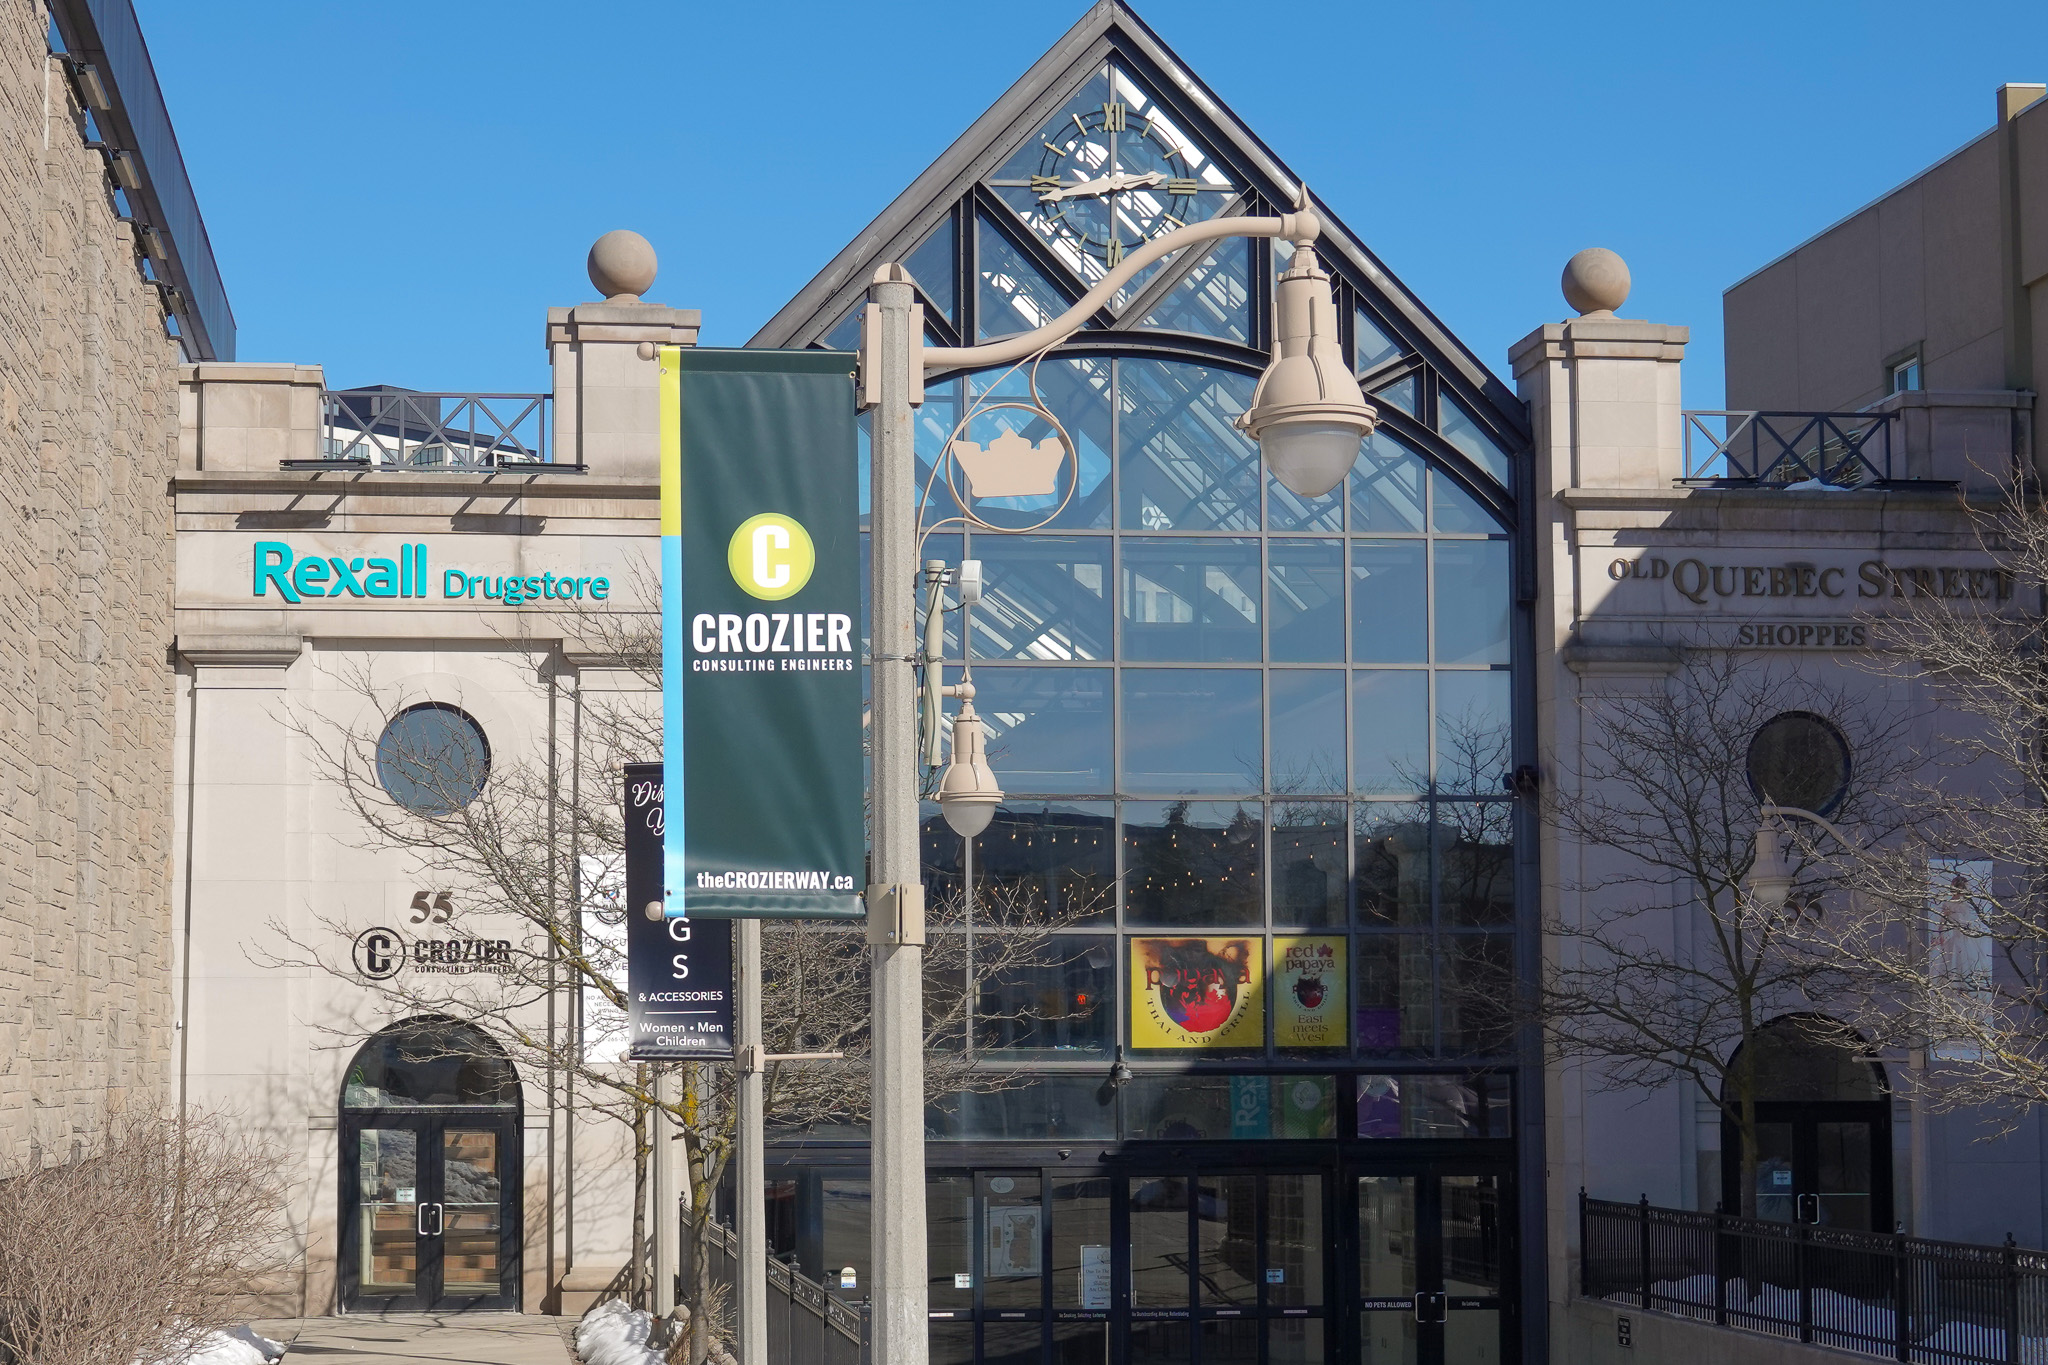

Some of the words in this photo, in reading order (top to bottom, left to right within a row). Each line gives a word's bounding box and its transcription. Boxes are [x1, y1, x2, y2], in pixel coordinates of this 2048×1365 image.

[254, 541, 428, 604] Rexall
[444, 569, 610, 606] Drugstore
[1609, 558, 1670, 580] OLD
[1673, 558, 1845, 604] QUEBEC
[1858, 560, 2013, 600] STREET
[692, 613, 852, 653] CROZIER
[1739, 624, 1866, 646] SHOPPES
[693, 659, 775, 672] CONSULTING
[781, 658, 853, 671] ENGINEERS
[696, 871, 854, 890] theCROZIERWAY.ca
[409, 891, 453, 924] 55
[585, 938, 627, 947] HAIRCU
[414, 939, 511, 963] CROZIER
[1286, 944, 1314, 958] red
[415, 965, 465, 973] CONSULTING
[1286, 959, 1336, 975] papaya
[638, 993, 647, 1002] &
[649, 991, 724, 1002] ACCESSORIES
[1146, 997, 1172, 1035] THAI
[1176, 1034, 1212, 1044] AND
[1220, 991, 1251, 1037] GRILL
[1298, 1014, 1323, 1023] East
[639, 1022, 685, 1033] Women
[697, 1022, 723, 1033] Men
[1293, 1024, 1329, 1033] meets
[656, 1036, 706, 1046] Children
[1296, 1033, 1325, 1041] West
